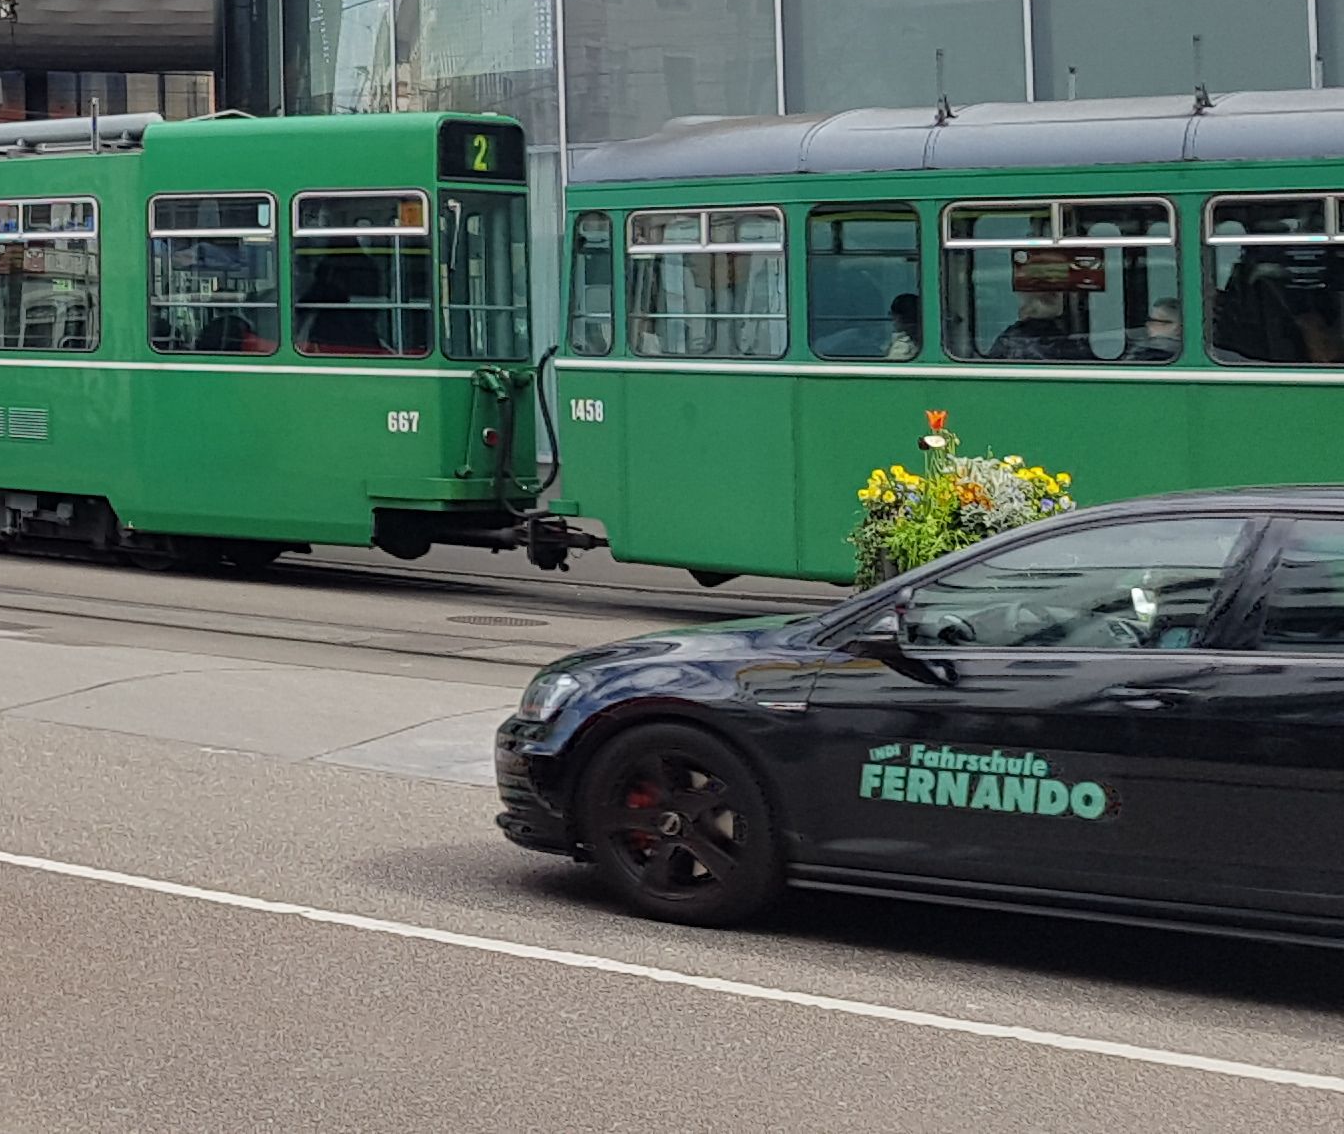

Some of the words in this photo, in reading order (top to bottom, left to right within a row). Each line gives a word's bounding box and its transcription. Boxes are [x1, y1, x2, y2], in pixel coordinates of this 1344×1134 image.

[473, 134, 488, 171] 2
[387, 411, 419, 432] 667
[570, 399, 604, 422] 1458
[910, 743, 1050, 777] Fahrschule
[859, 763, 1106, 820] FERNANDO
